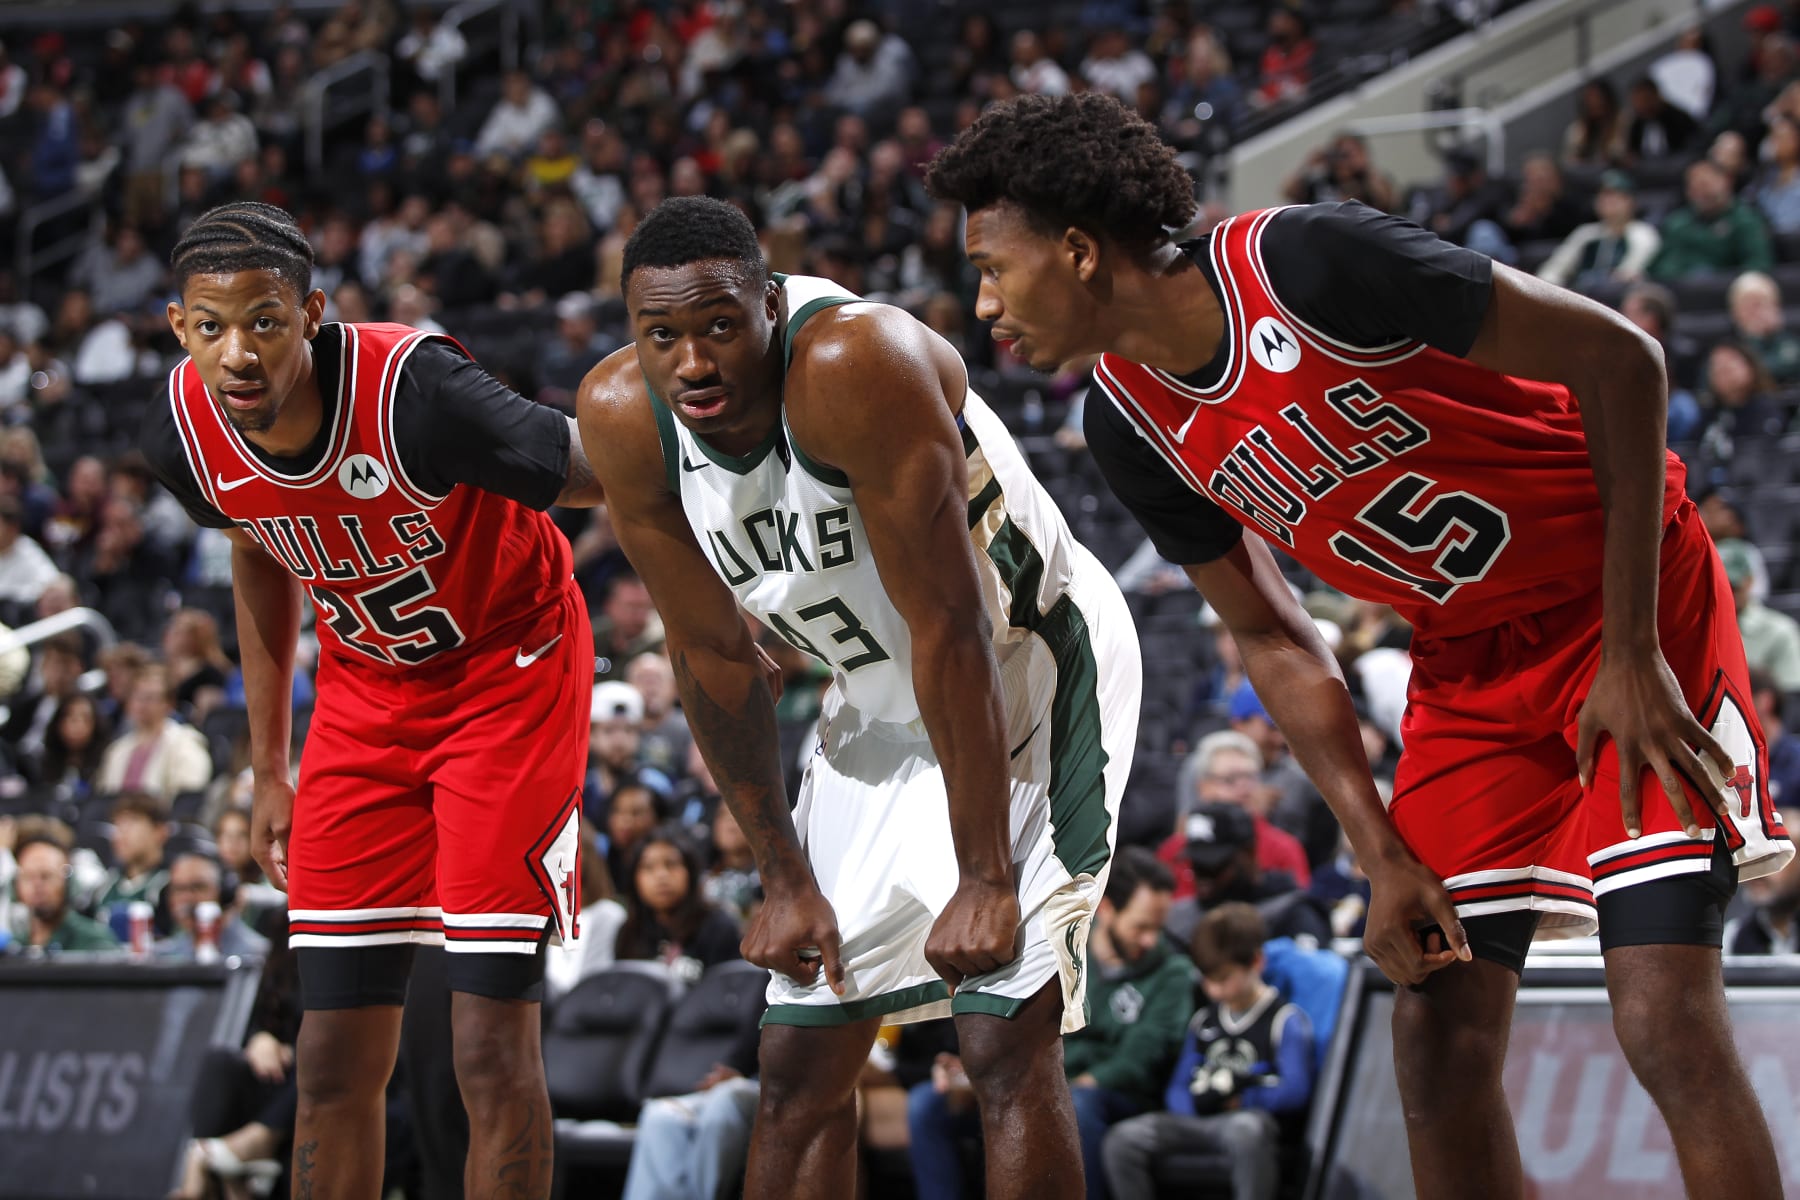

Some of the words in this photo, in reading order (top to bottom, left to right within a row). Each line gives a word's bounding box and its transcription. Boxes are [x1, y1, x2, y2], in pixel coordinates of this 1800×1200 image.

[1208, 377, 1431, 549] BULLS
[1327, 471, 1511, 606] 15
[309, 564, 466, 667] 25
